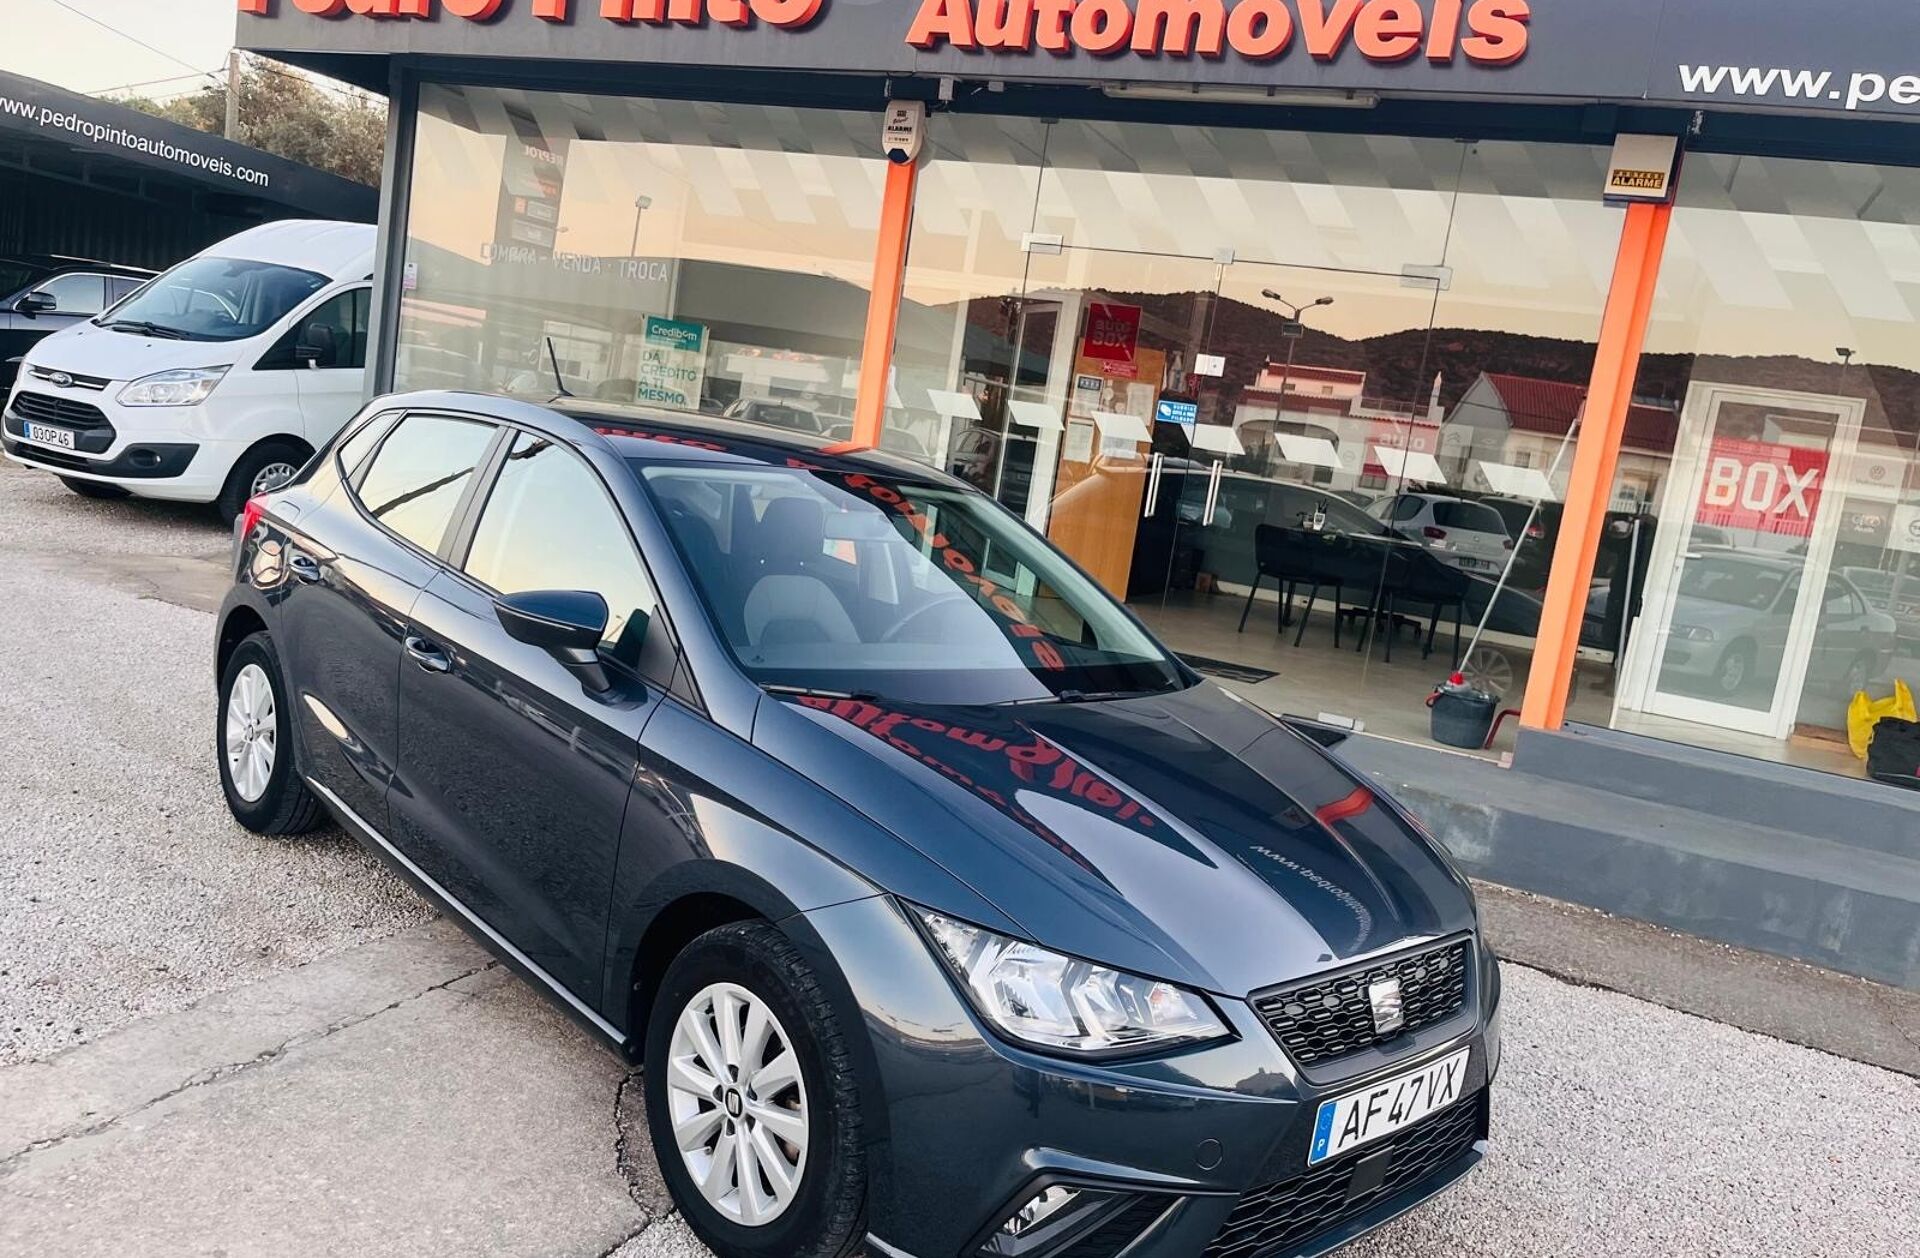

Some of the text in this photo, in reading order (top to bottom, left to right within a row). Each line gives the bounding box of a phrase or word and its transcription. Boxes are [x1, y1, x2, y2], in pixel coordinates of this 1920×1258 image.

[904, 0, 1531, 64] Automoveis
[1612, 177, 1662, 188] ALARME
[552, 250, 601, 275] VENDA
[619, 260, 668, 282] TROCA
[651, 324, 697, 341] Credibom
[1704, 456, 1820, 518] BOX
